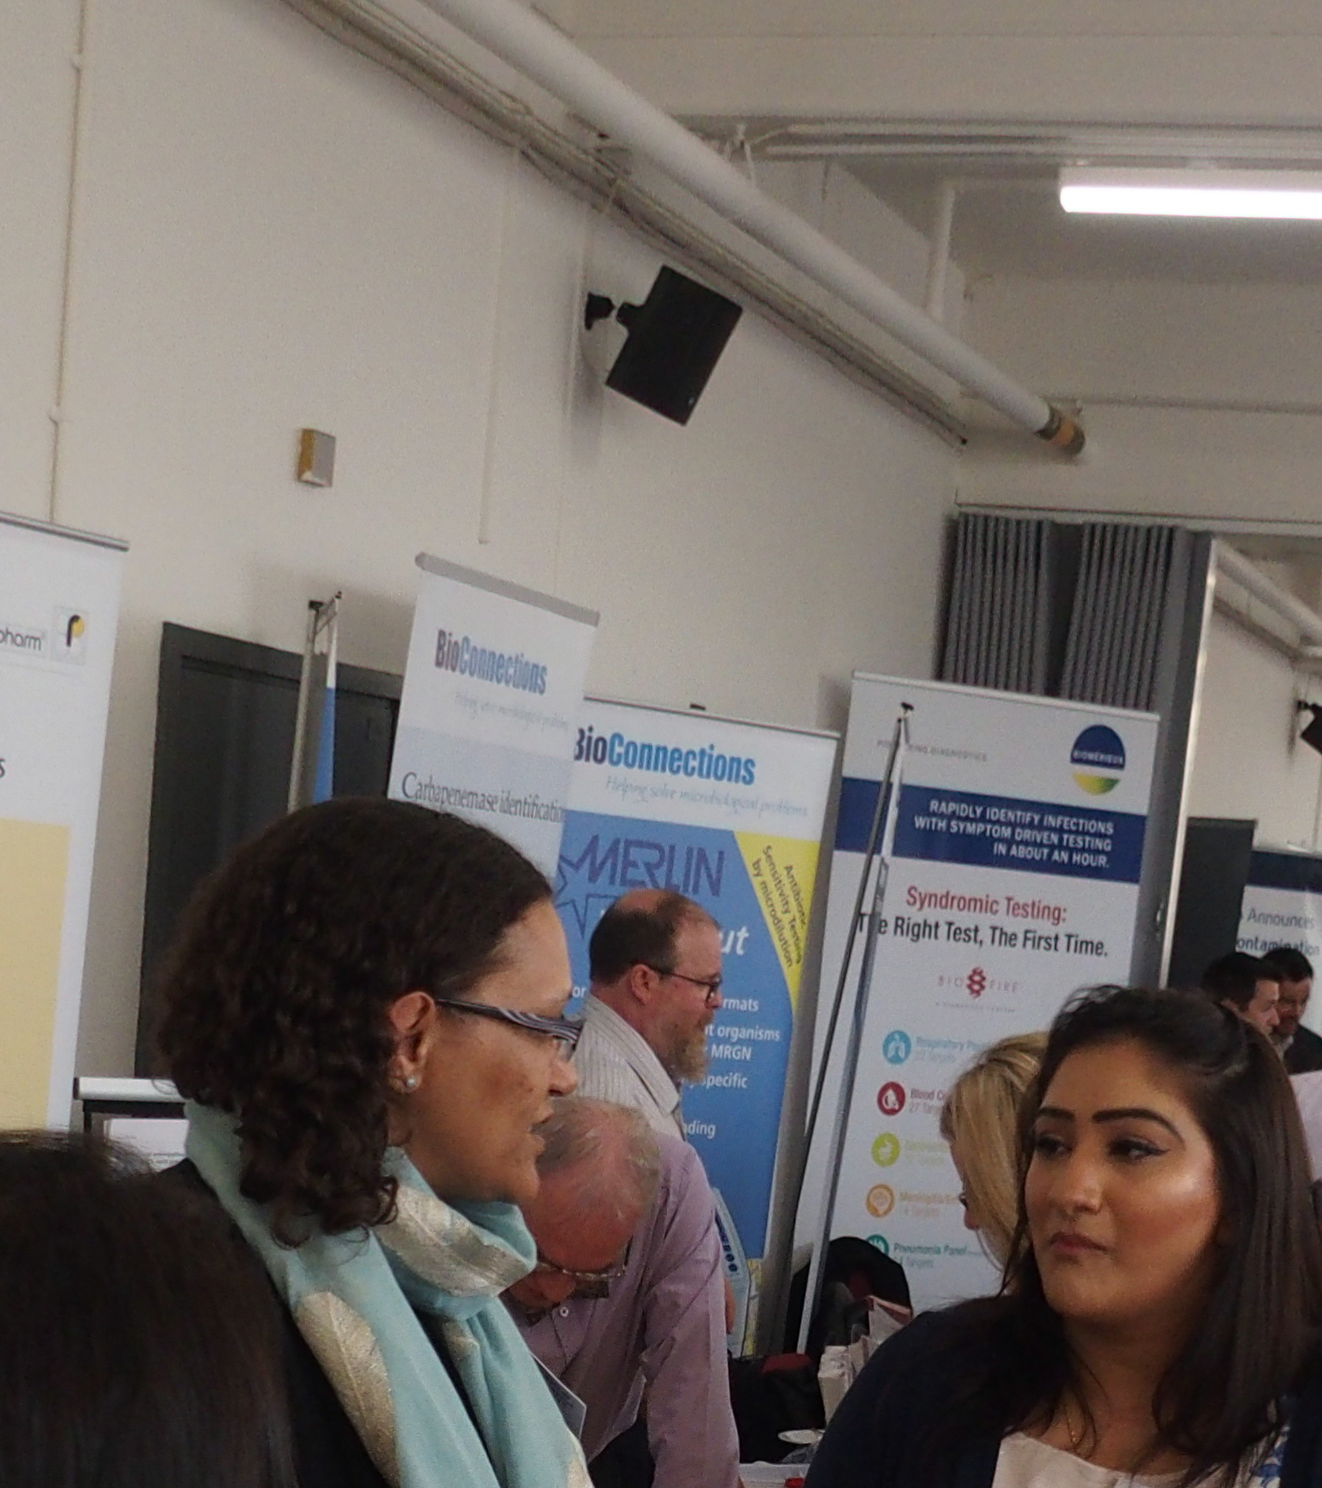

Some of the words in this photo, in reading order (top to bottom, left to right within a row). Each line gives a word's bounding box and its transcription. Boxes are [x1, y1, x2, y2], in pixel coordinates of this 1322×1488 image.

[434, 629, 548, 696] BioConnections
[574, 725, 756, 786] BioConnections
[402, 771, 498, 813] Carbapenemase
[914, 815, 947, 832] WITH
[949, 818, 1011, 839] SYMPTOM
[1014, 827, 1058, 845] DRIVEN
[1062, 834, 1112, 852] TESTING
[930, 799, 982, 818] RAPIDLY
[986, 808, 1040, 826] IDENTIFY
[1043, 815, 1114, 835] INFECTIONS
[574, 834, 725, 897] MERLIN
[993, 844, 1006, 856] IN
[1009, 845, 1048, 862] ABOUT
[1052, 851, 1069, 864] AN
[1072, 853, 1110, 868] HOUR.
[762, 845, 790, 915] Sensitivity
[752, 859, 763, 877] by
[760, 880, 794, 967] microdilution
[906, 885, 999, 916] Syndromic
[1005, 897, 1067, 926] Testing:
[857, 911, 889, 935] Te
[893, 916, 939, 943] Right
[945, 922, 983, 947] Test,
[989, 926, 1018, 948] The
[1022, 929, 1059, 952] First
[1065, 934, 1108, 957] Time.
[1237, 936, 1320, 956] ontamination
[711, 1044, 752, 1060] MRGN
[717, 1025, 781, 1042] organisms
